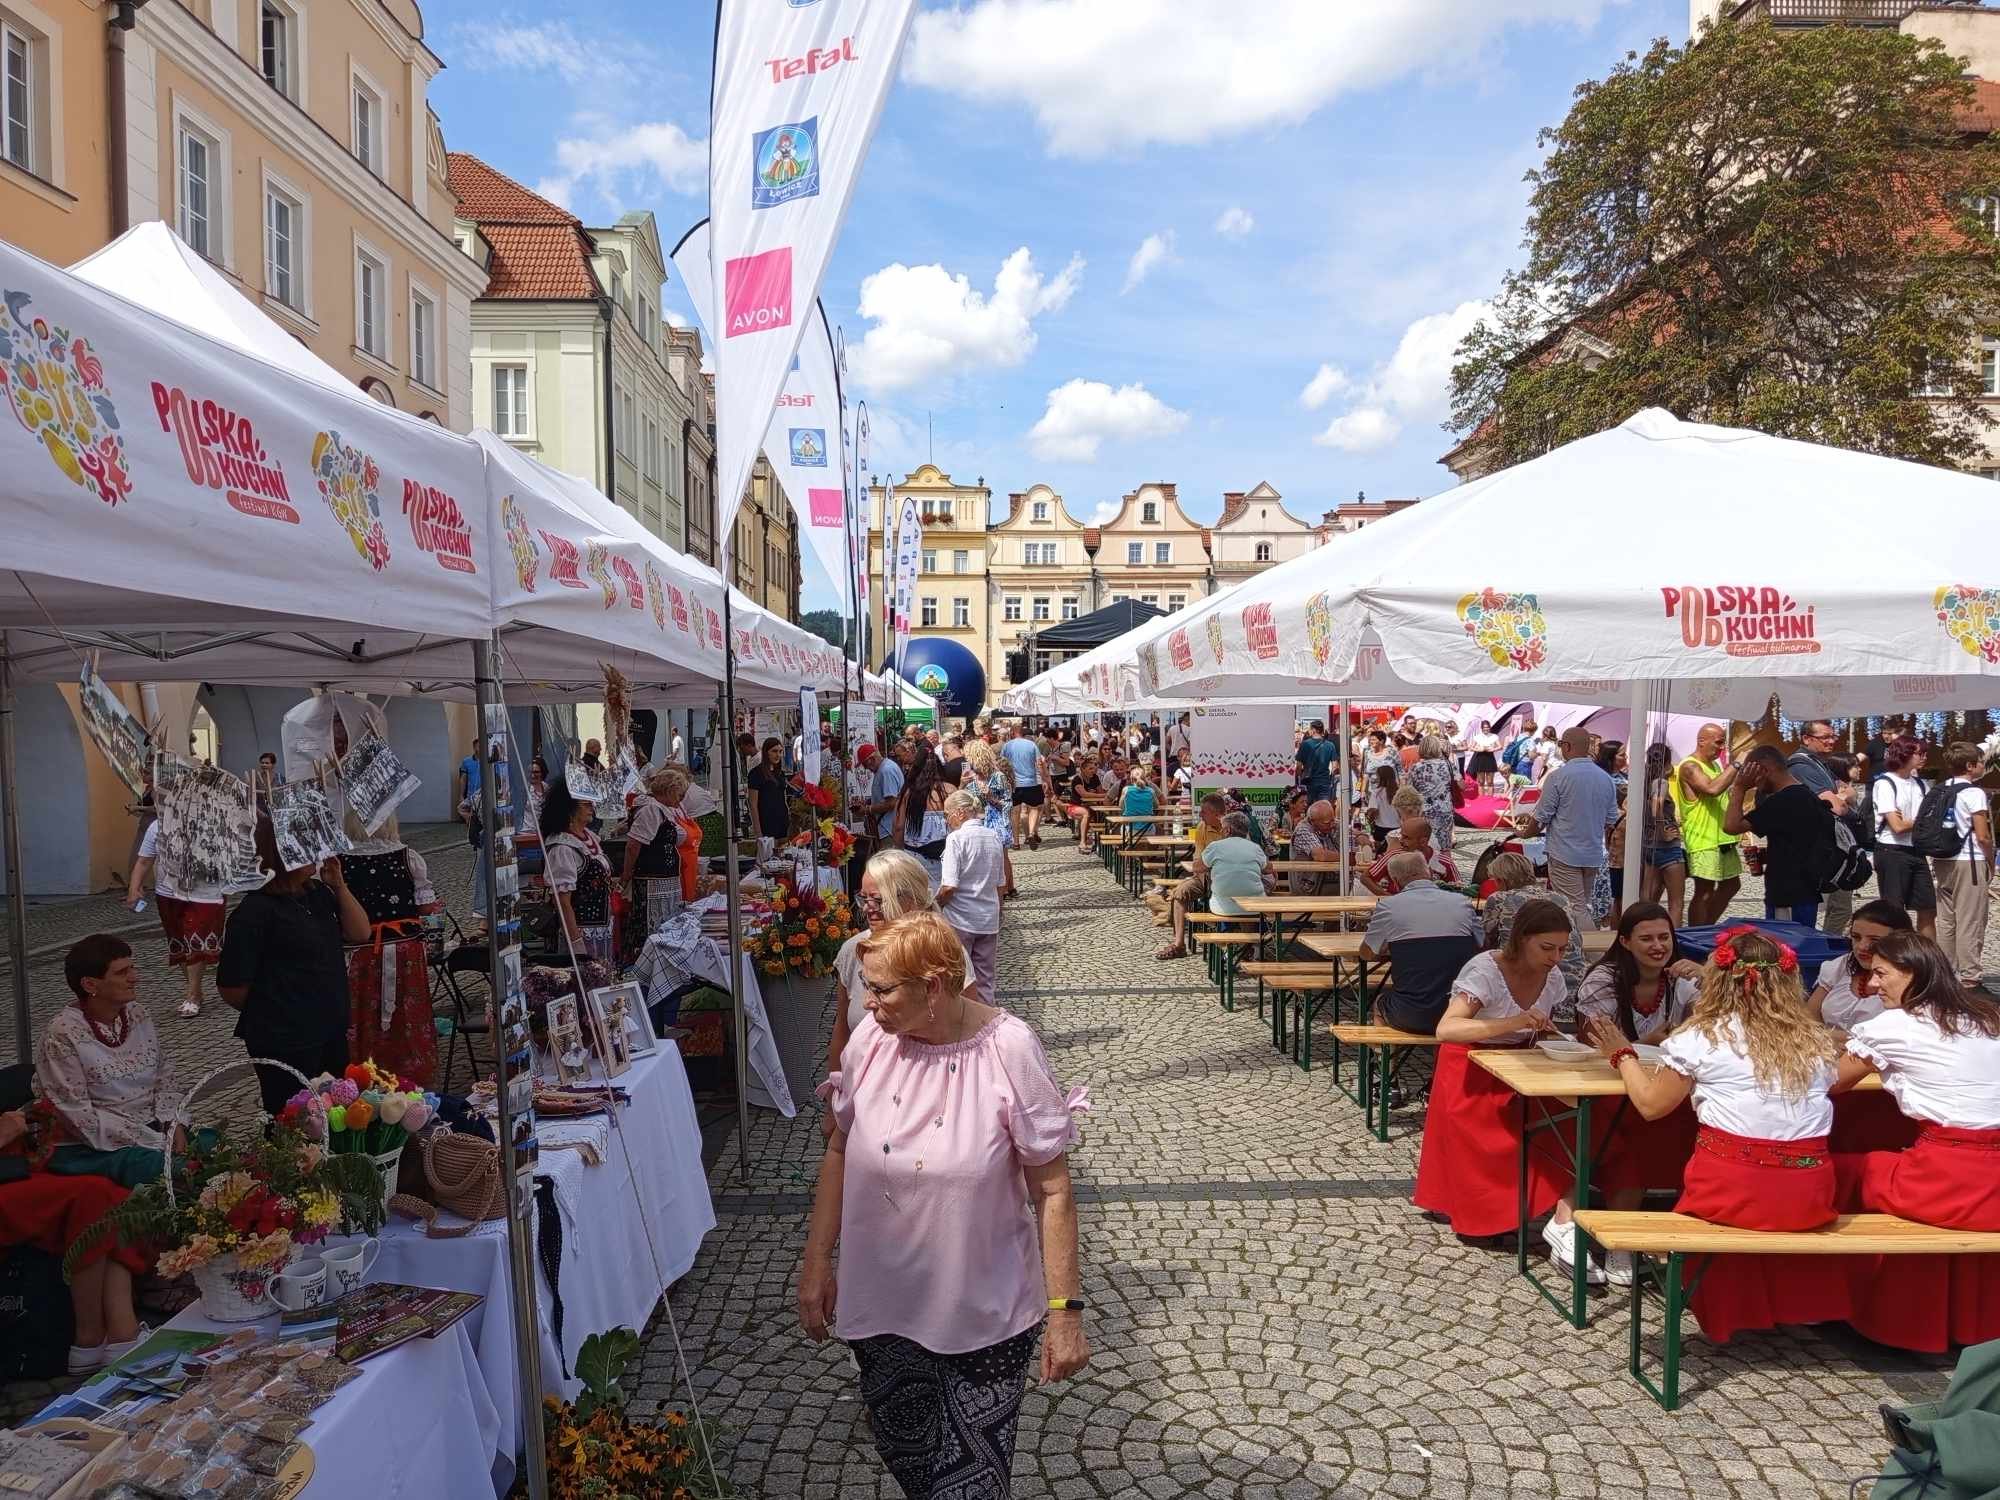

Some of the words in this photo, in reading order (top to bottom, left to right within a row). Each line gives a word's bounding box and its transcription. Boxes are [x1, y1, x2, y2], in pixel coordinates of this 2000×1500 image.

[766, 36, 858, 84] Tefal
[733, 306, 784, 330] AVON
[151, 382, 259, 486] POLSKA
[217, 452, 291, 502] KUCHNI
[403, 478, 458, 550] POLSKA
[431, 524, 472, 558] KUCHNI
[1661, 585, 1780, 648] POLSKA
[1726, 606, 1815, 641] KUCHNI
